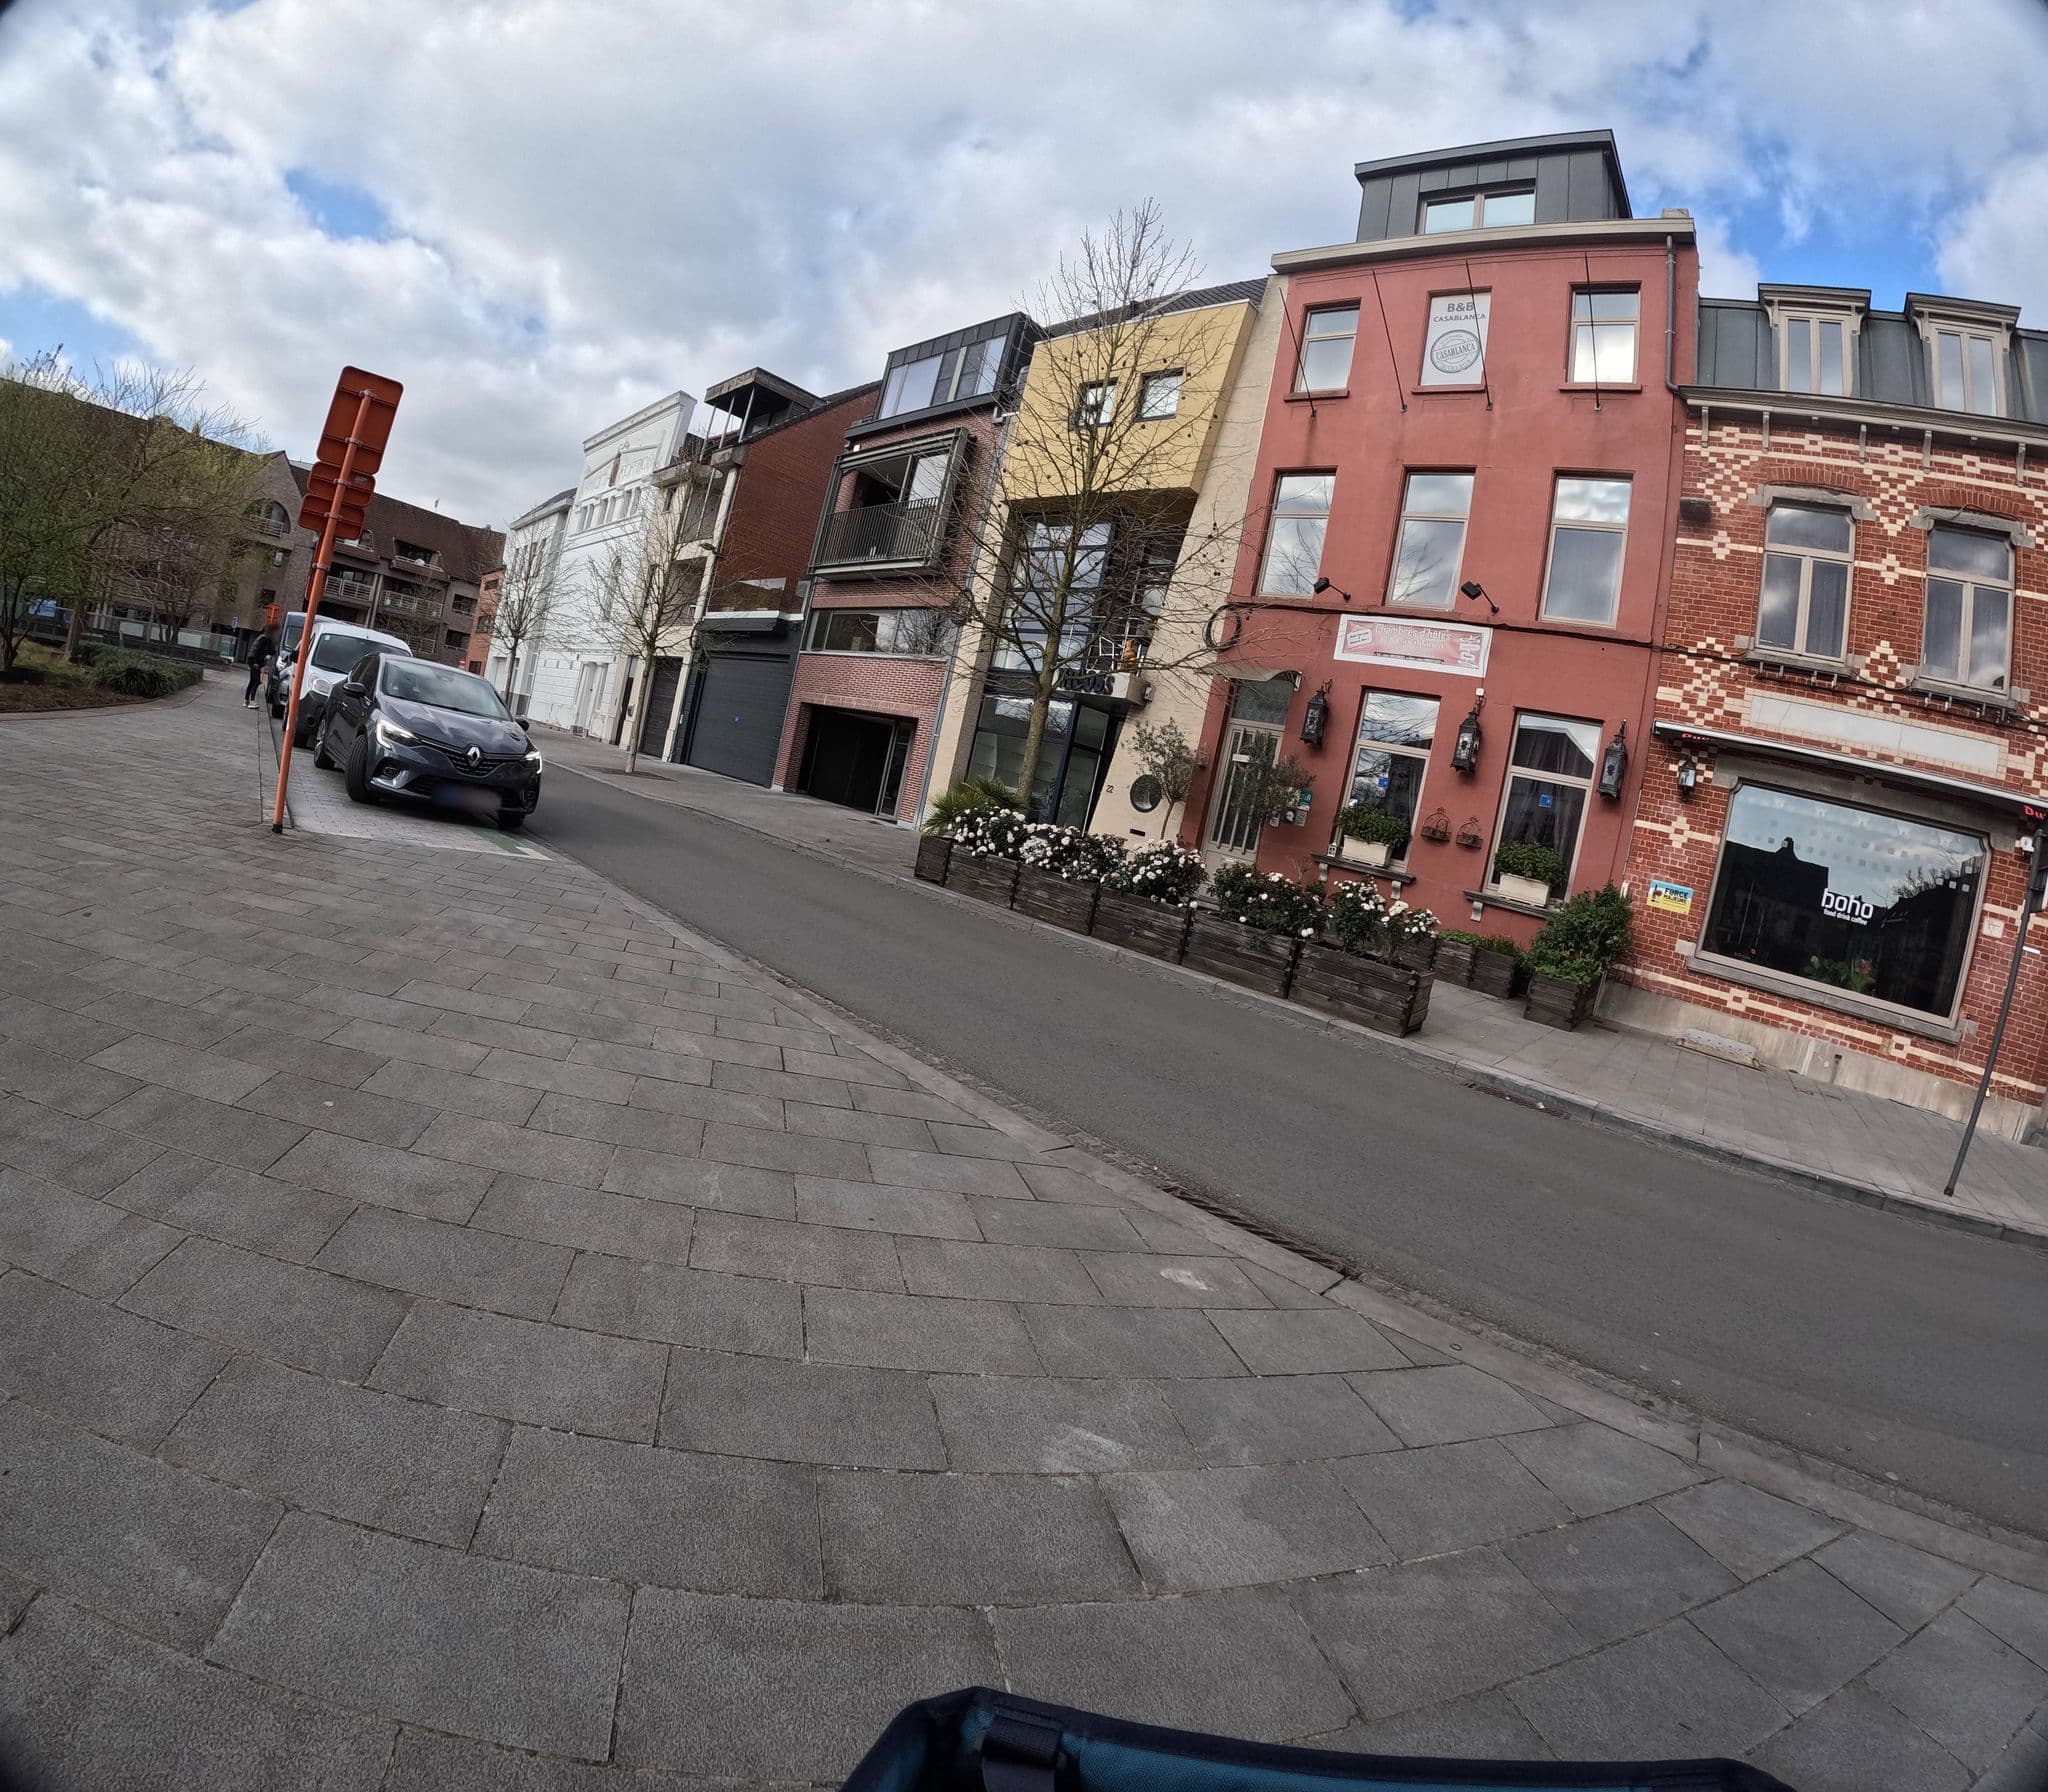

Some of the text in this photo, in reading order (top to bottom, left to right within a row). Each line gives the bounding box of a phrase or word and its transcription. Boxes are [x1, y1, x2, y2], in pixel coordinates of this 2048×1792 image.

[1447, 302, 1475, 313] B&B
[1433, 313, 1486, 322] CASABLANCA
[1435, 342, 1476, 360] CASABLANCA
[1106, 784, 1115, 794] 22
[1821, 888, 1873, 919] boho
